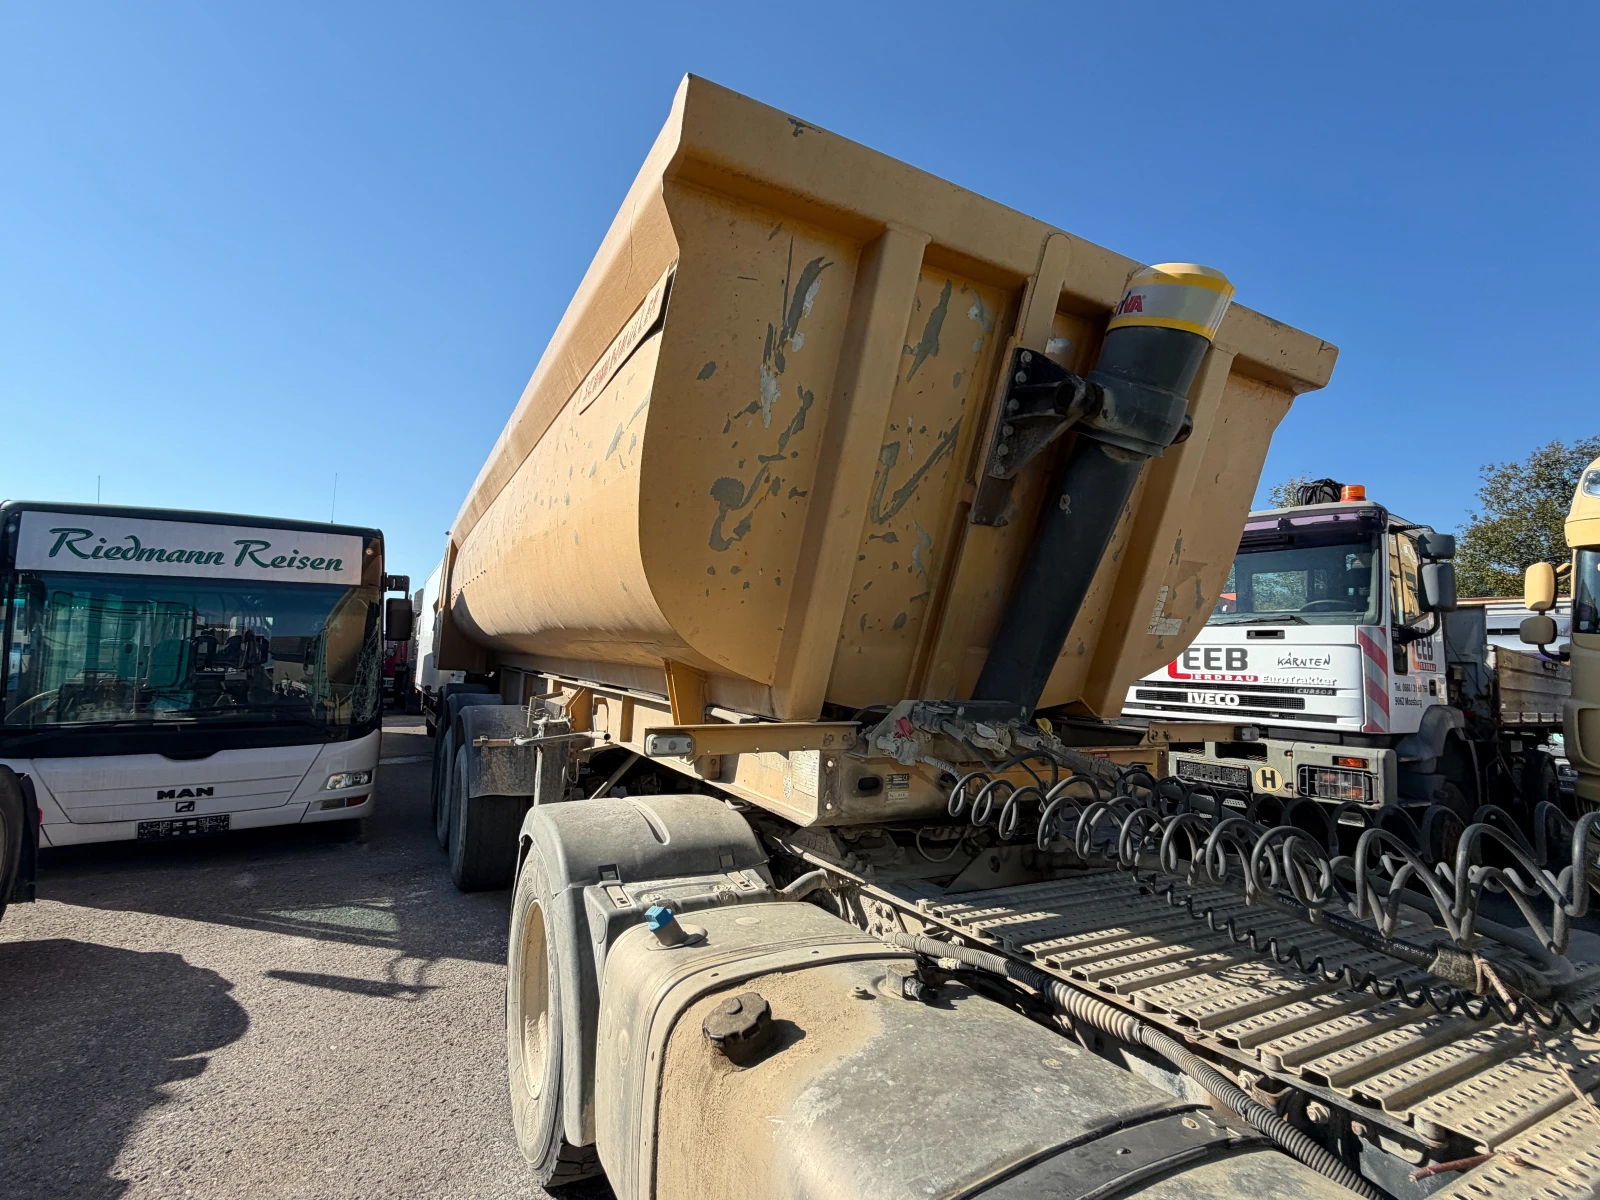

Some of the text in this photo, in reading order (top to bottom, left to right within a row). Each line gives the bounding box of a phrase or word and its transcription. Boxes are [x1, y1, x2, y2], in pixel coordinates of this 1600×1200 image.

[49, 528, 344, 572] Riedmann Reisen
[1194, 674, 1255, 682] ERDBAU
[1187, 692, 1240, 706] IVECO
[1261, 770, 1277, 789] H
[157, 787, 214, 800] MAN
